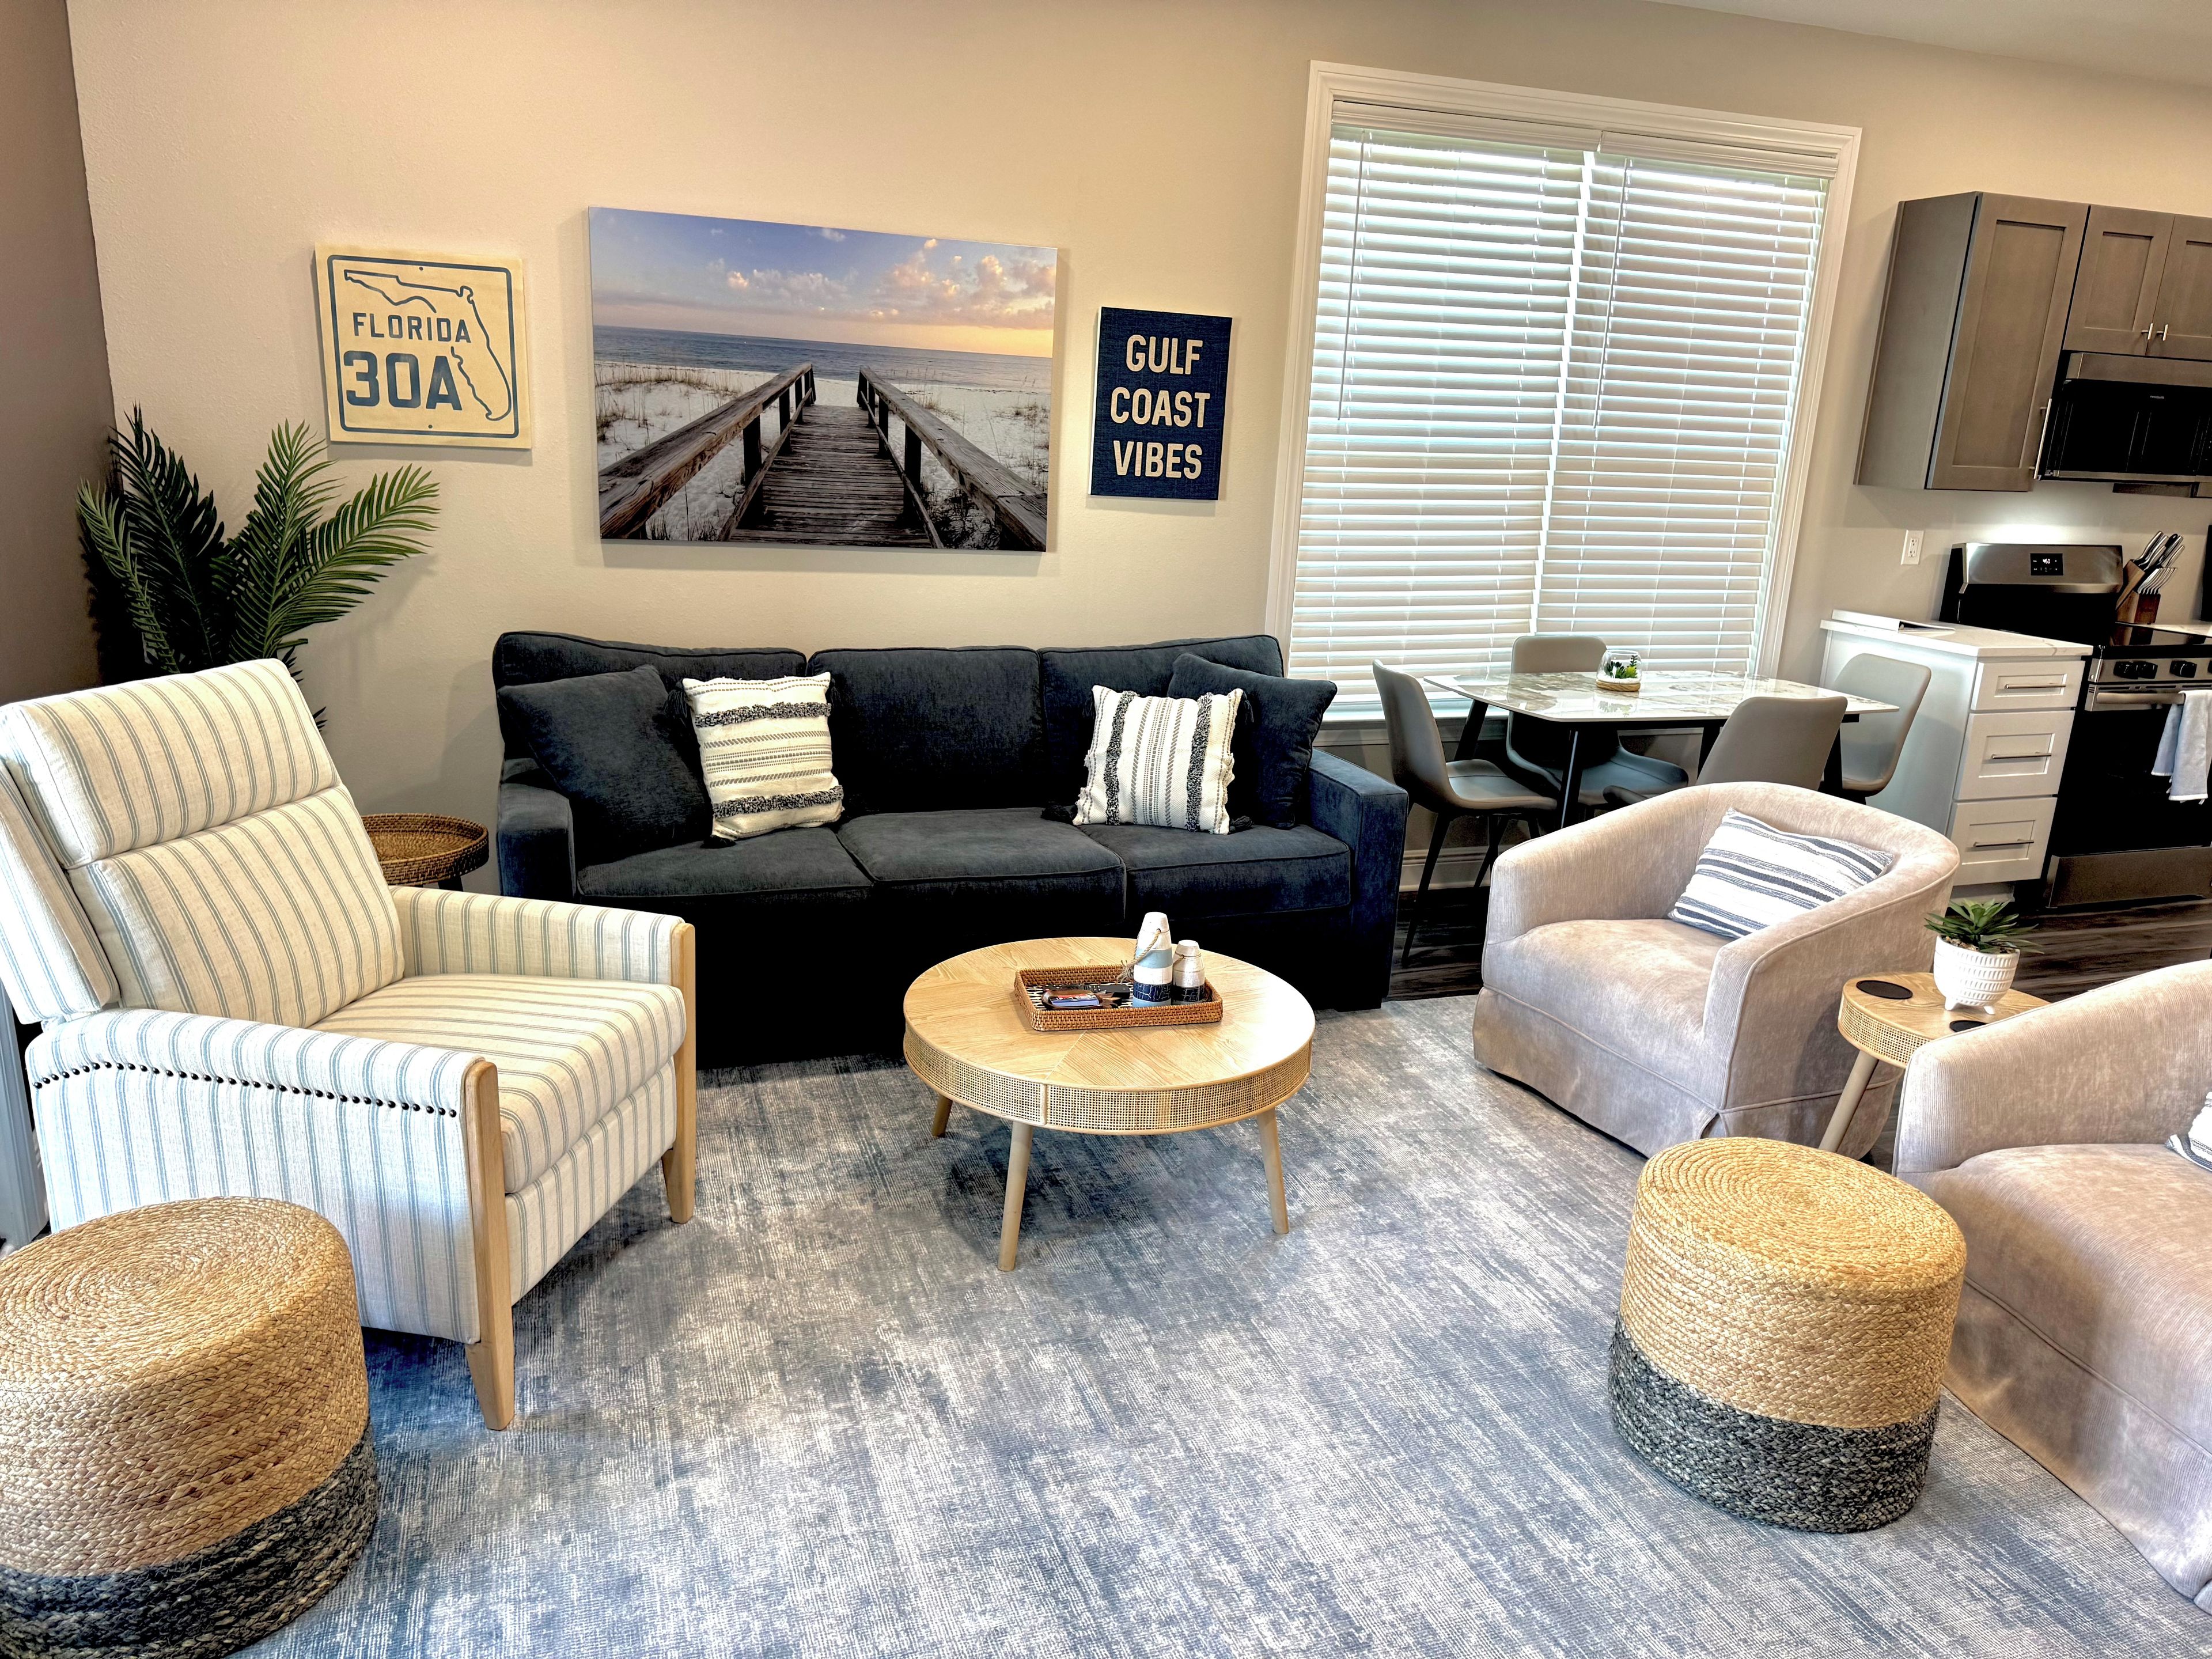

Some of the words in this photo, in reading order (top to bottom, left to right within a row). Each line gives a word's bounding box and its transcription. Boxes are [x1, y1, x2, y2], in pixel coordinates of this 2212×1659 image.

[353, 312, 471, 343] FLORIDA
[1126, 334, 1203, 374] GULF
[343, 350, 463, 411] 30A
[1111, 387, 1210, 427] COAST
[1113, 440, 1203, 479] VIBES
